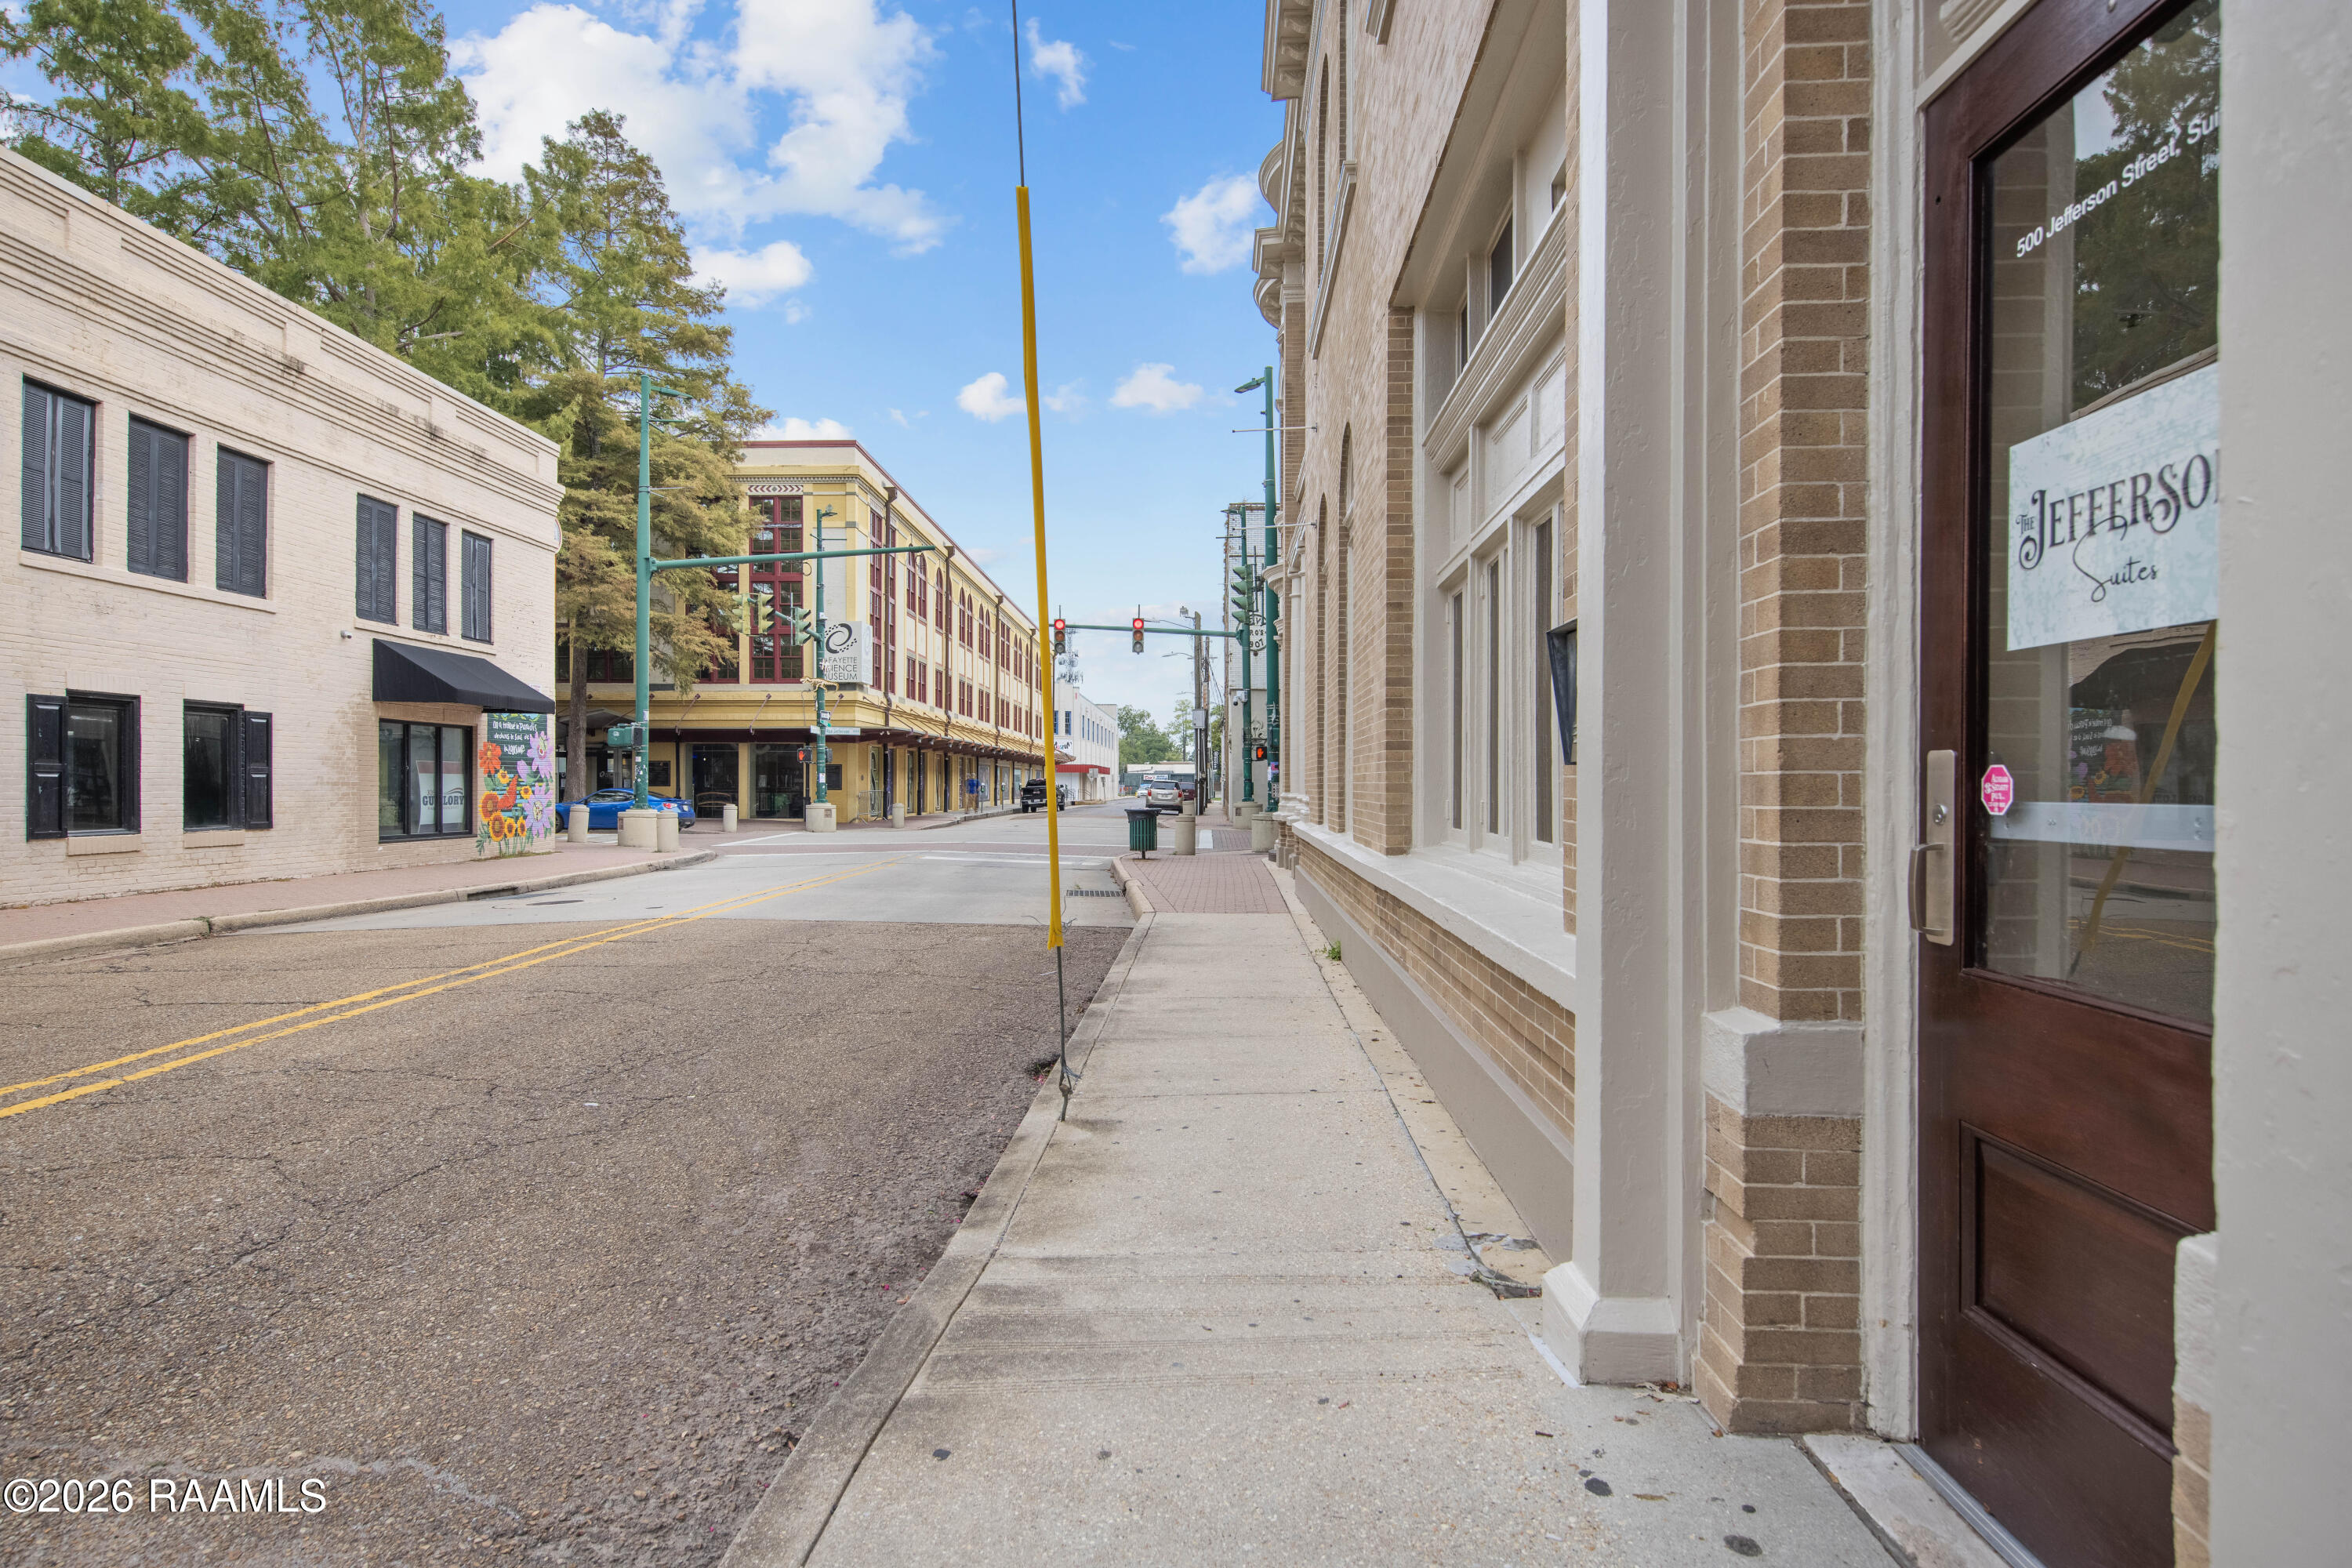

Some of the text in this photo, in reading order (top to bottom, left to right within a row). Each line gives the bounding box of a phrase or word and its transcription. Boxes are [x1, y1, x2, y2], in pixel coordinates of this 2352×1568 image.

[2016, 226, 2043, 257] 500
[2046, 180, 2117, 238] Jefferson
[2122, 136, 2182, 187] Street,
[2073, 515, 2158, 602] Suites
[422, 795, 464, 806] GULORY
